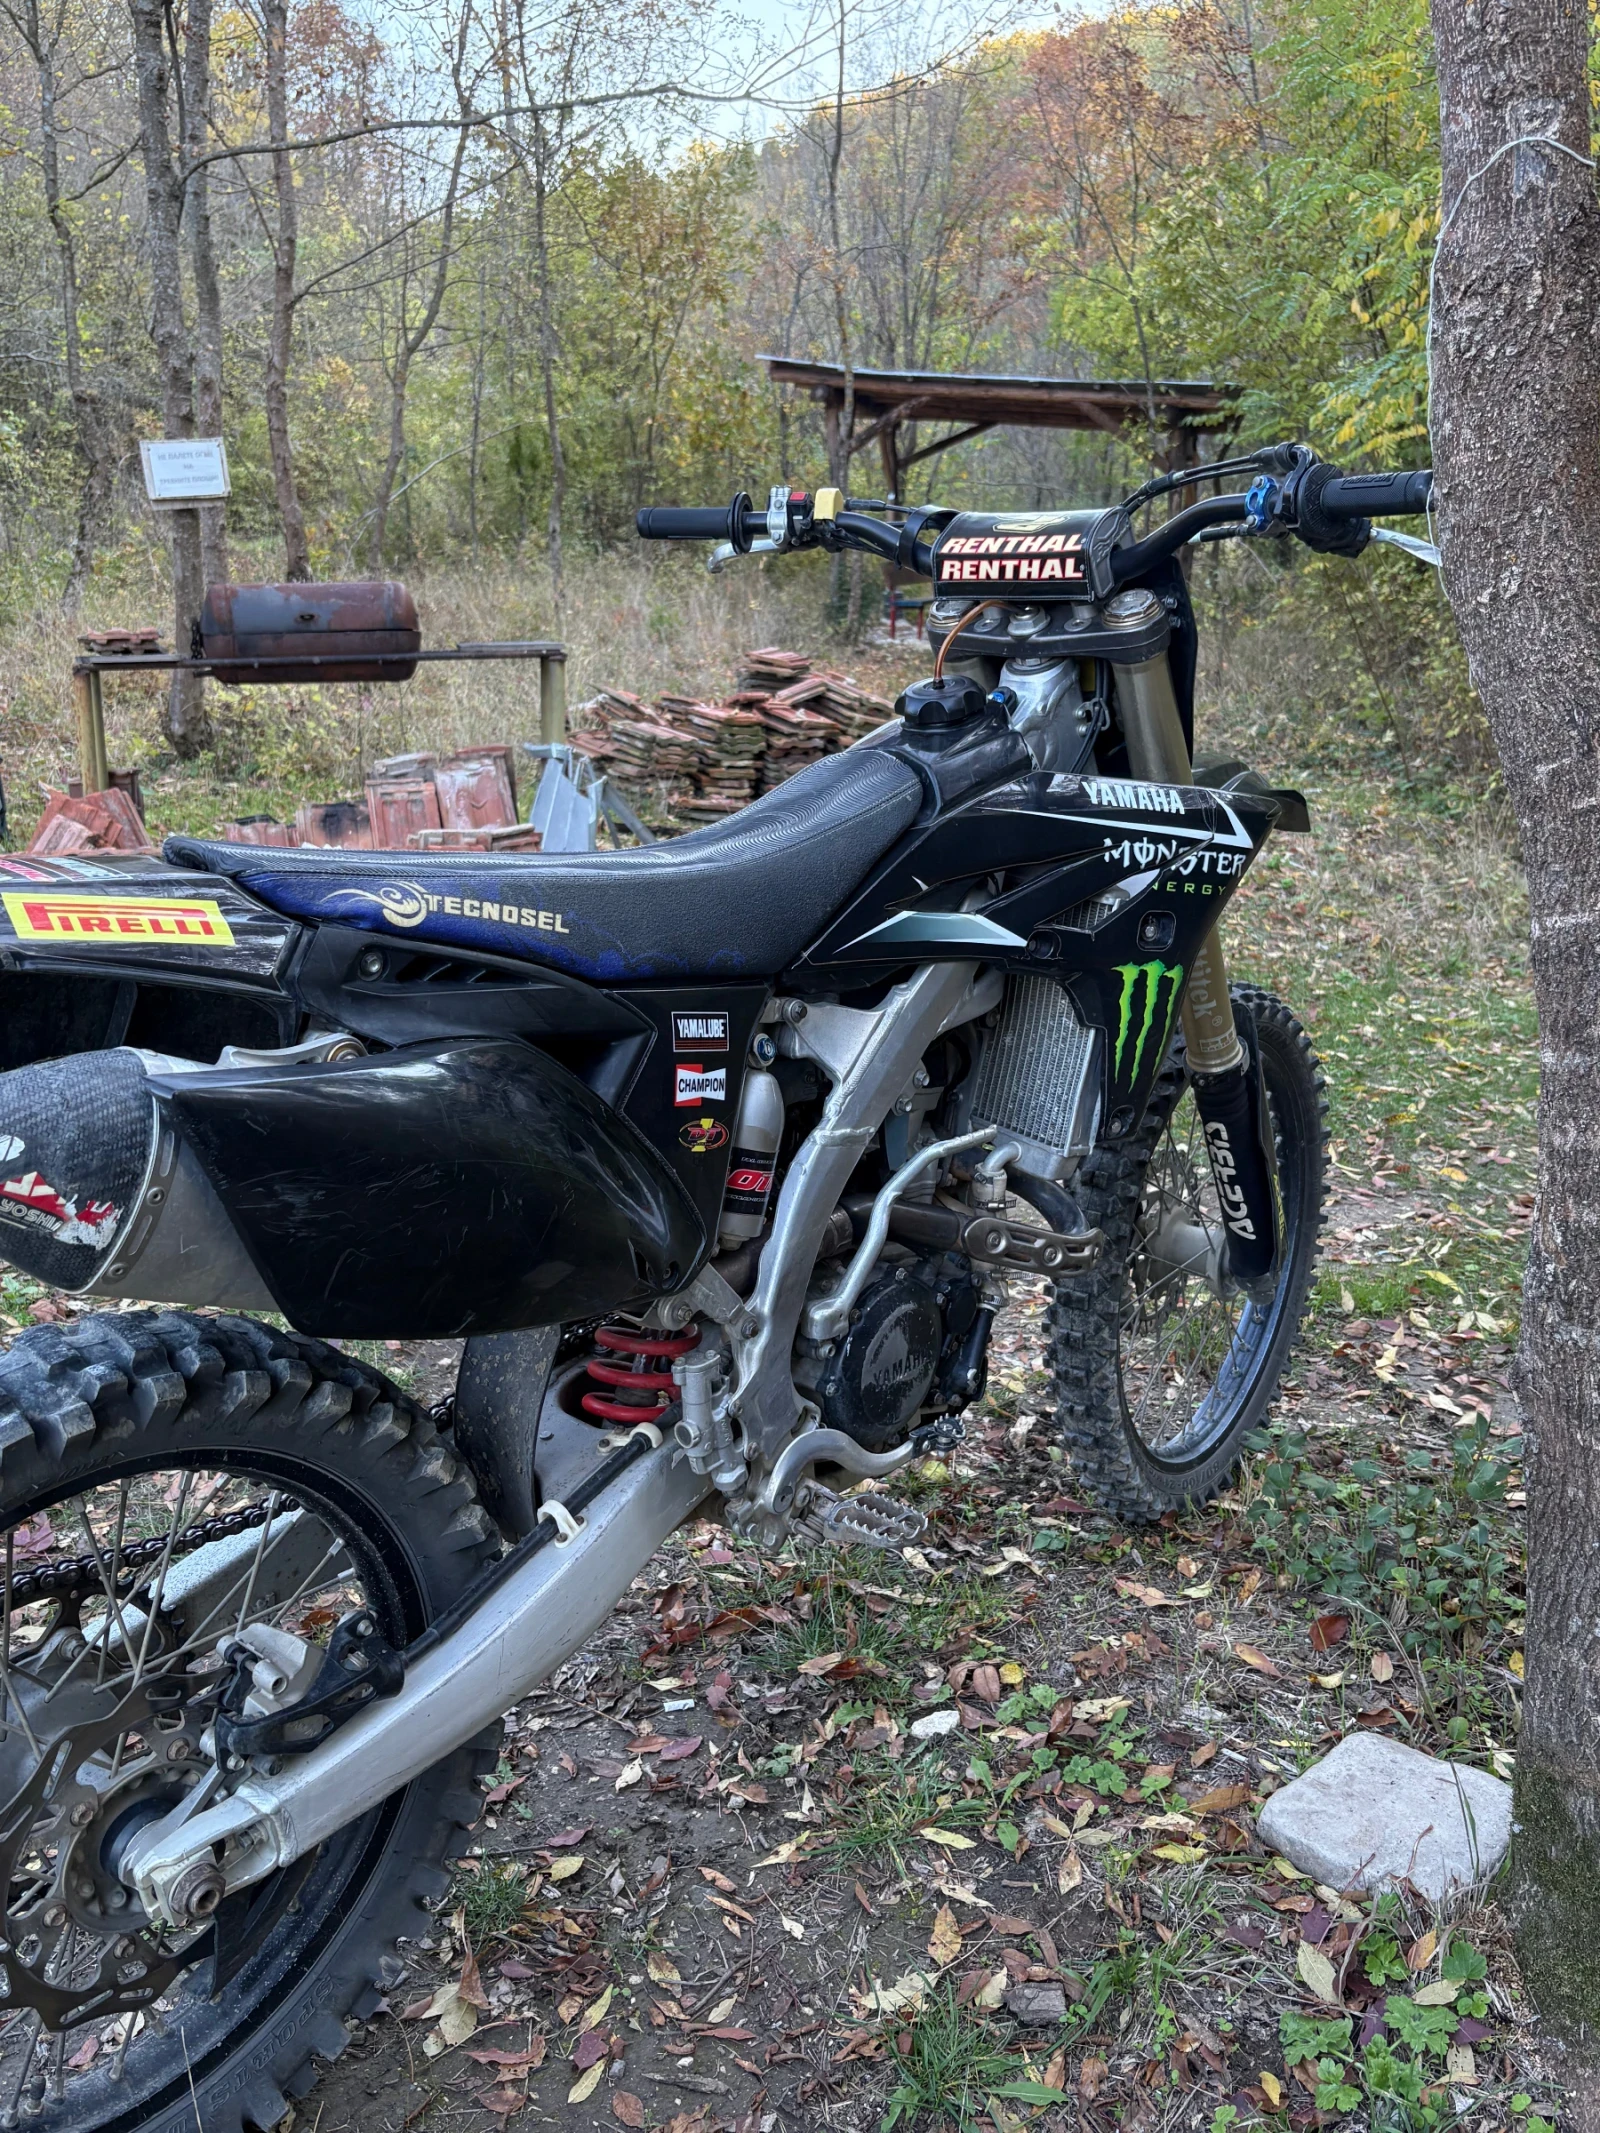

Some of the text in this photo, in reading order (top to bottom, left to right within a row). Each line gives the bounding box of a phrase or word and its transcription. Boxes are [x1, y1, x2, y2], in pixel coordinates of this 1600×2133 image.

[940, 534, 1083, 554] RENTHAL
[941, 557, 1083, 581] RENTHAL
[1082, 781, 1185, 815] YAMAHA
[22, 902, 215, 936] PIRELLI
[423, 894, 570, 934] TECNOSEL
[677, 1019, 726, 1038] YAMALUBE
[678, 1078, 725, 1093] CHAMPION
[1205, 1121, 1257, 1240] ACERBIS
